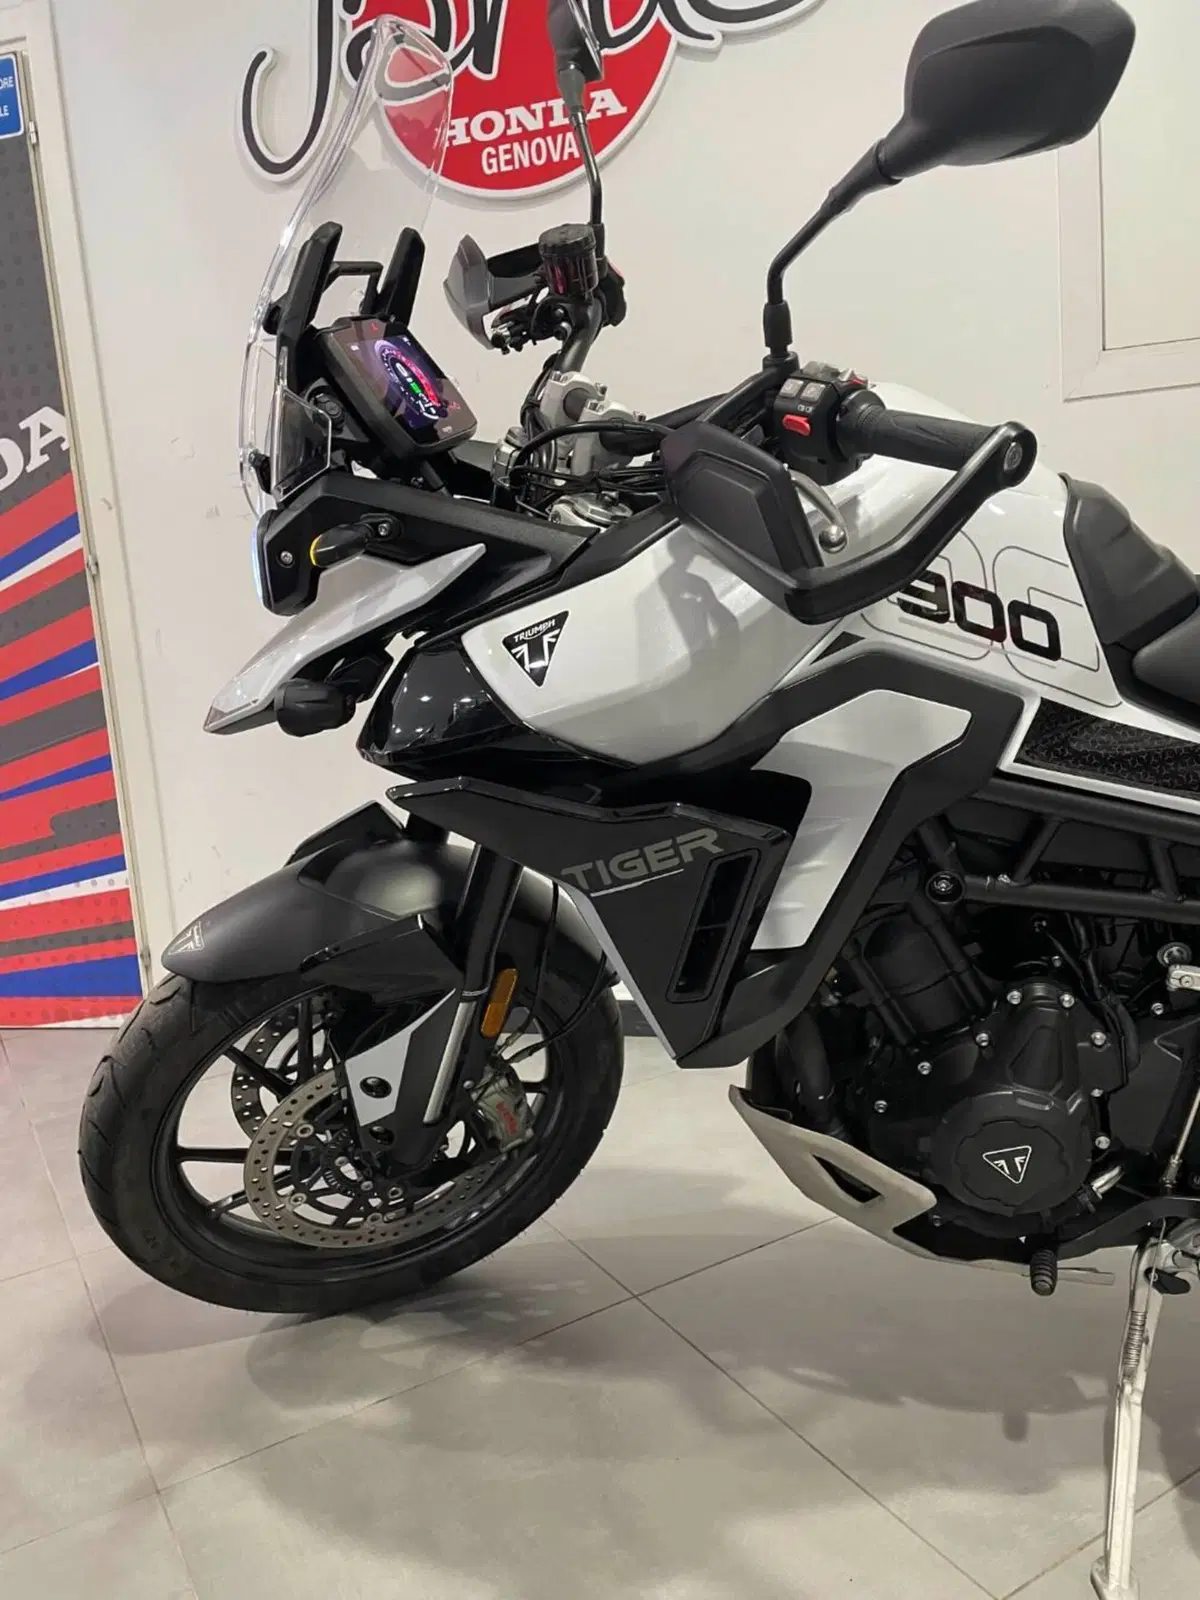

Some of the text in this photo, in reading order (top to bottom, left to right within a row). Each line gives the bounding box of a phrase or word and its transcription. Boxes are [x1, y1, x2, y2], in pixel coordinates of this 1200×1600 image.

[481, 132, 580, 175] GENOVA
[513, 619, 556, 643] TRIUMPH
[560, 827, 724, 890] TIGER
